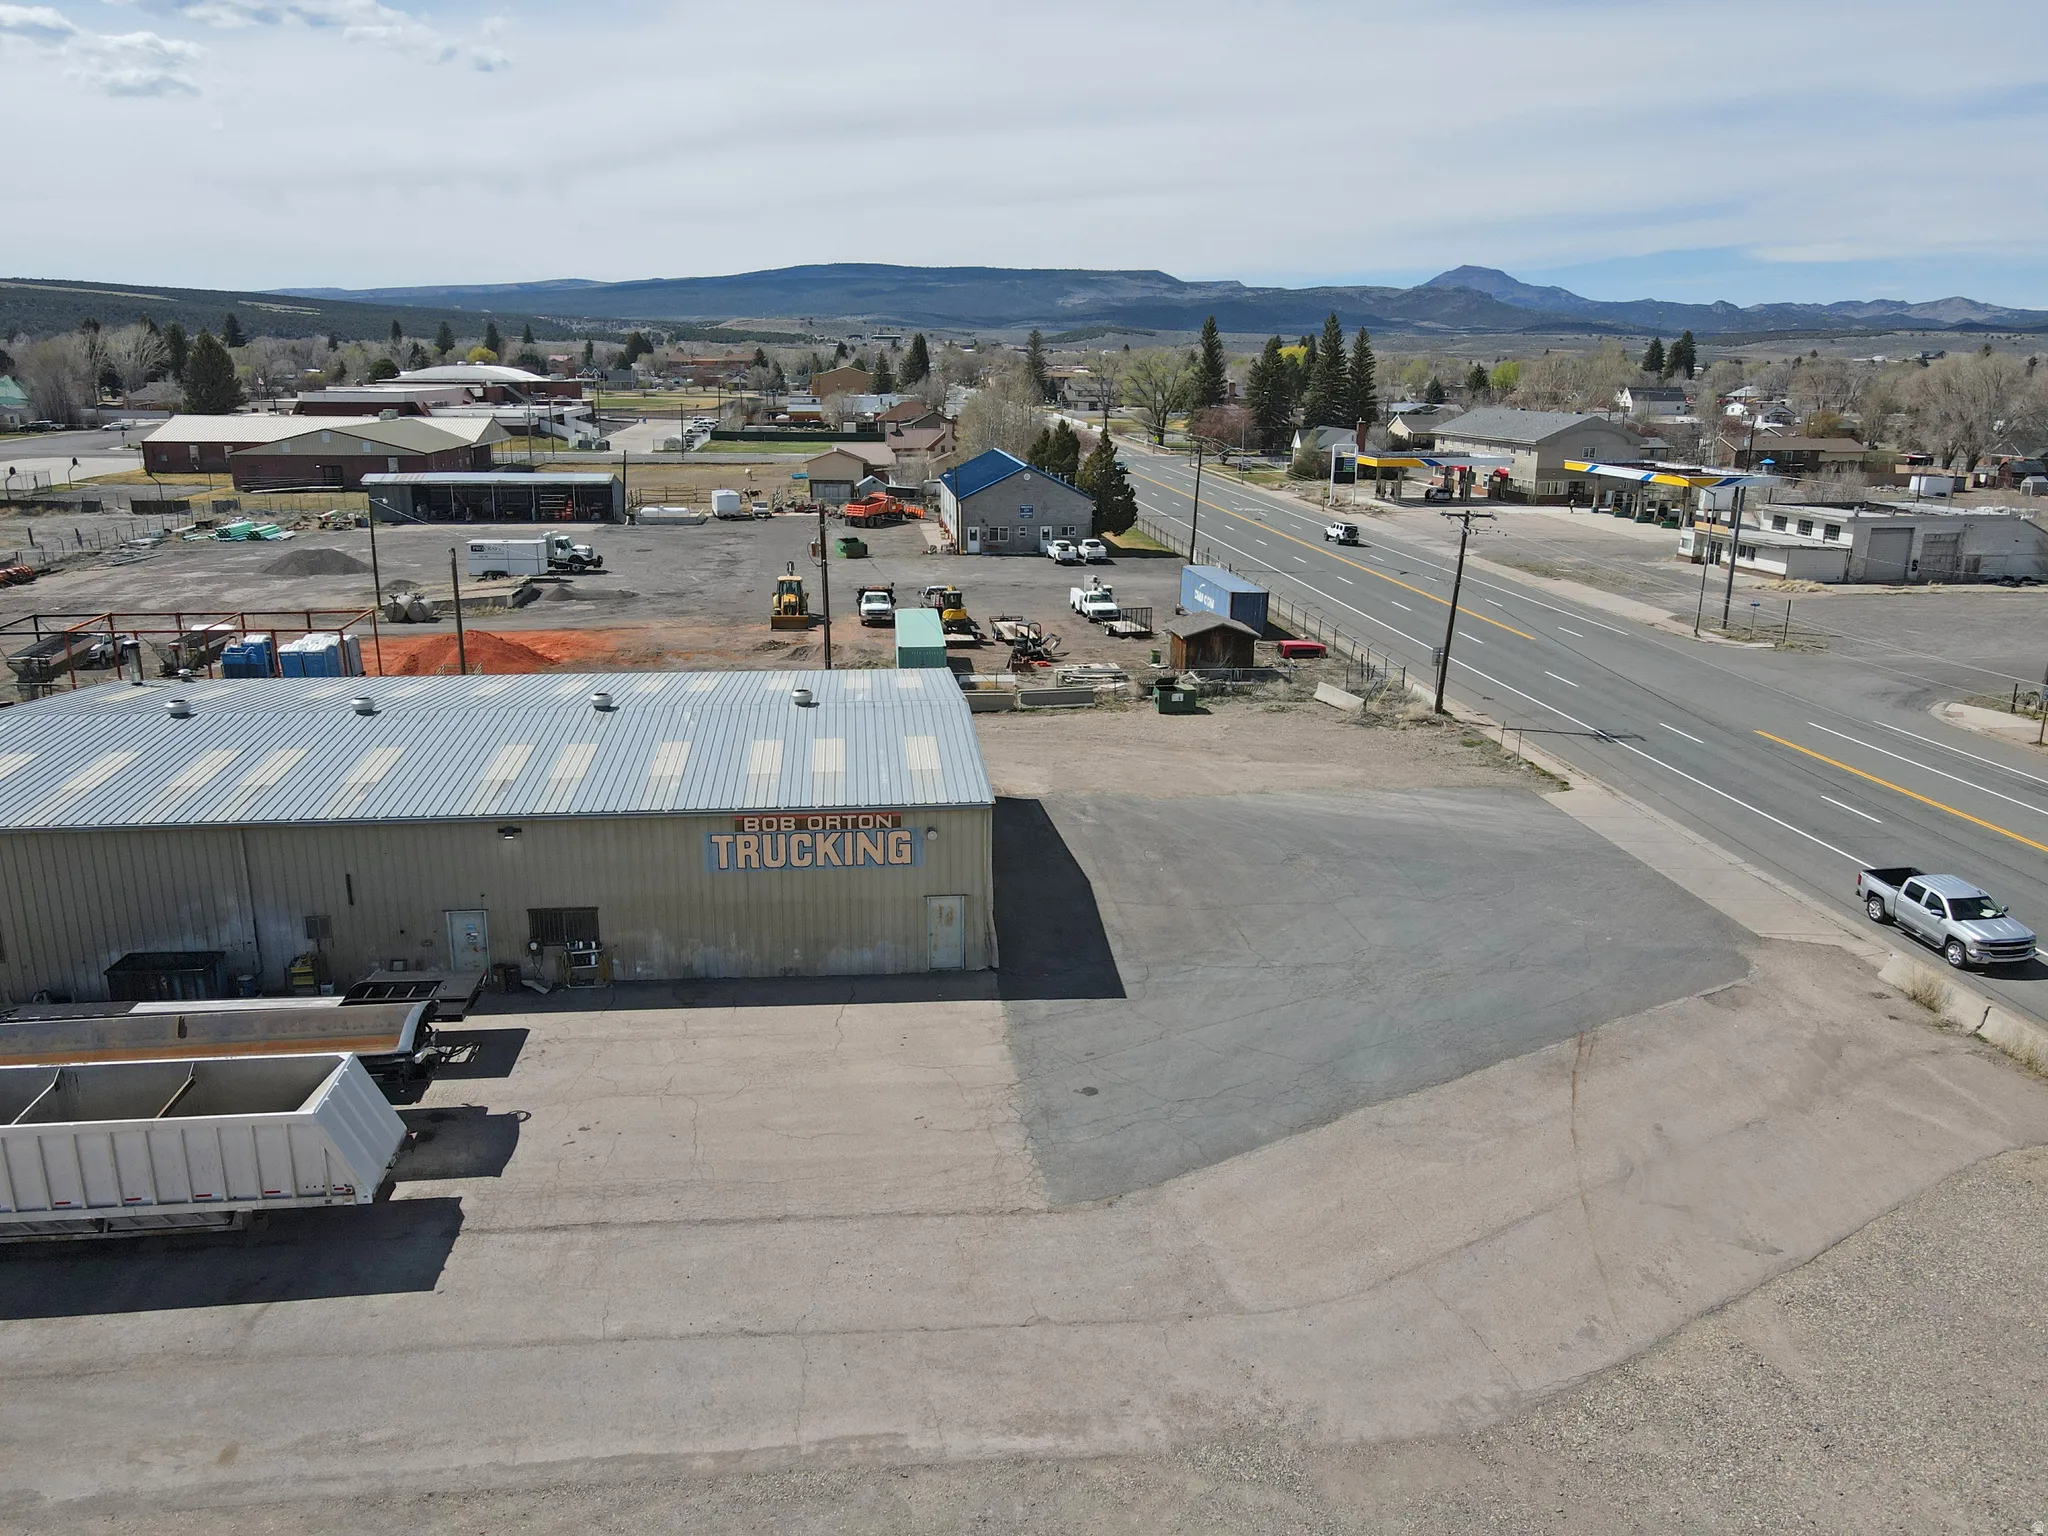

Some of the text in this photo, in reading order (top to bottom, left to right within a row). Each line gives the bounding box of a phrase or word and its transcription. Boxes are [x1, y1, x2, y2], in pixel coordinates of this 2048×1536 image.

[743, 813, 892, 832] BOB ORTON
[710, 829, 913, 870] TRUCKING
